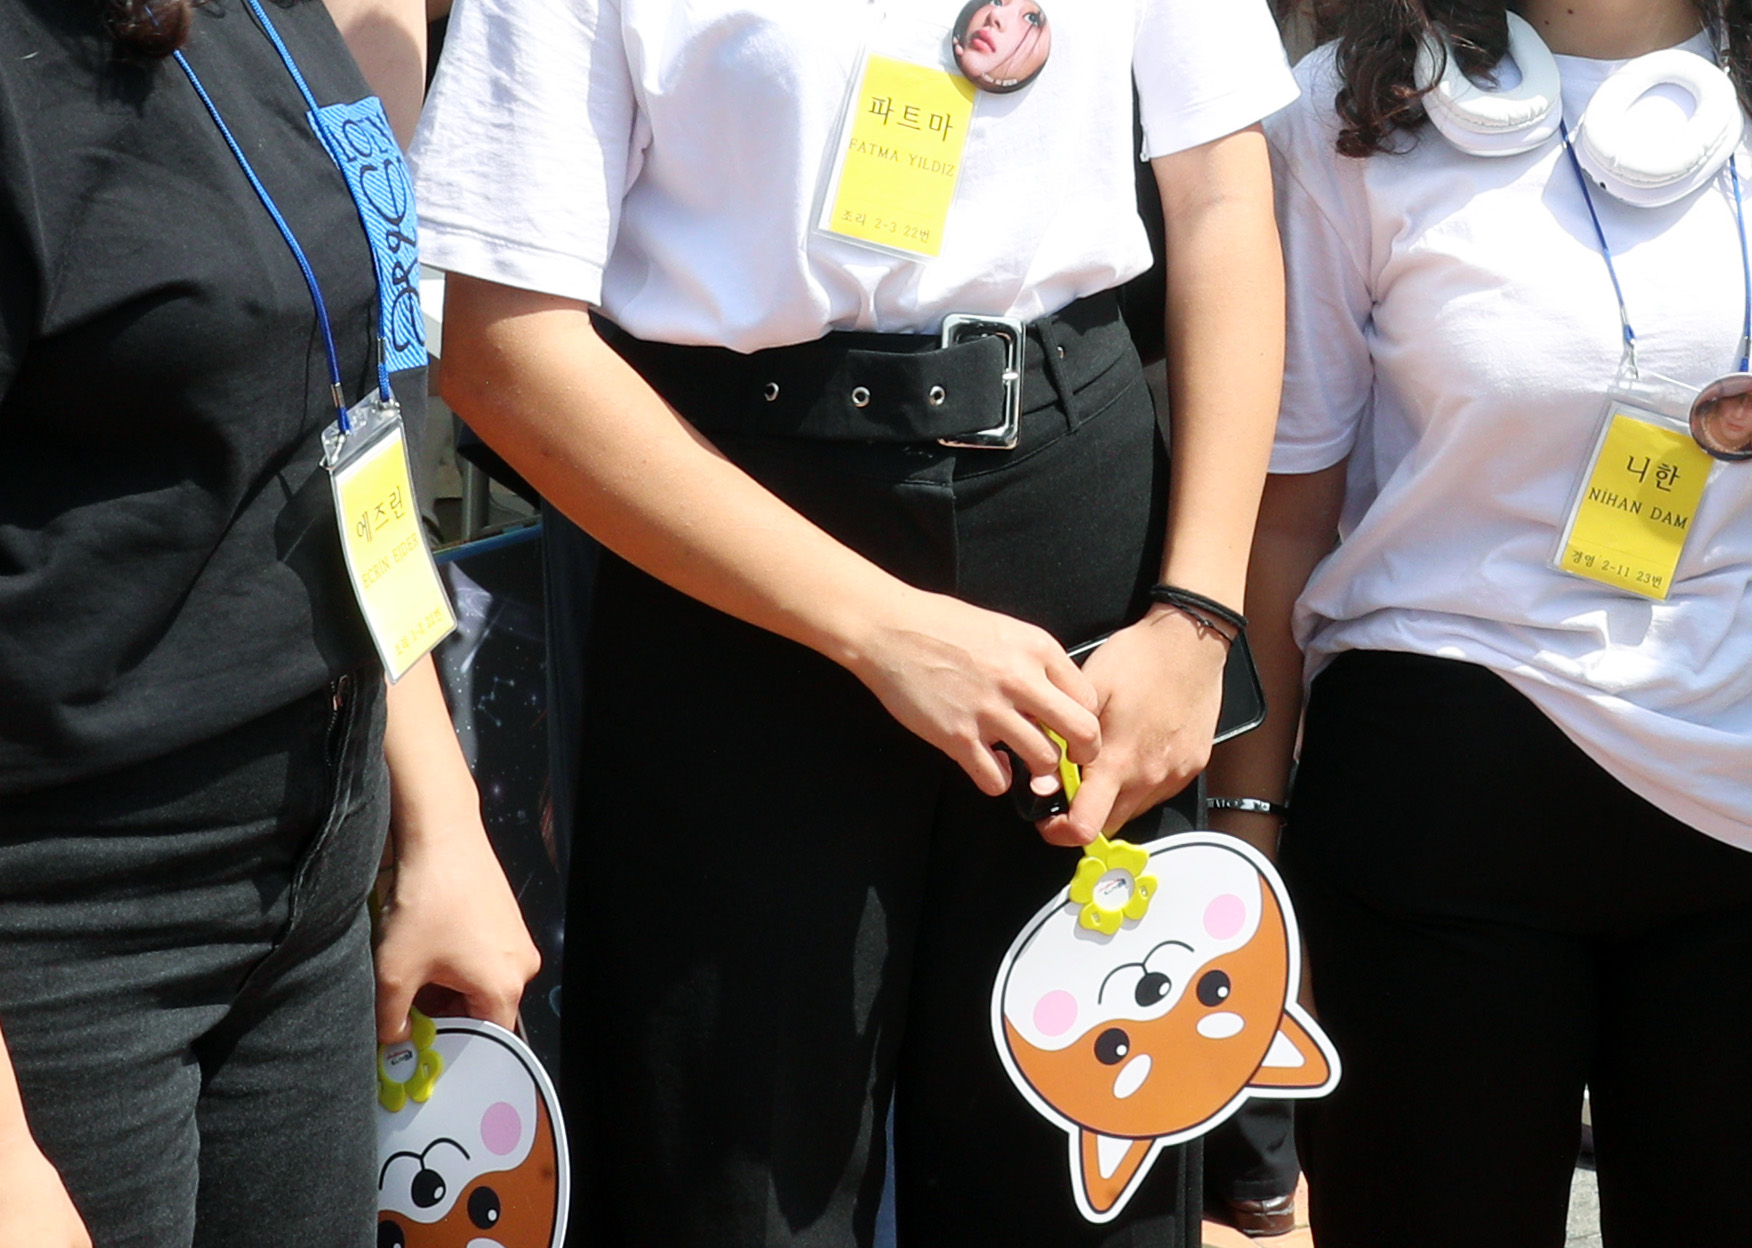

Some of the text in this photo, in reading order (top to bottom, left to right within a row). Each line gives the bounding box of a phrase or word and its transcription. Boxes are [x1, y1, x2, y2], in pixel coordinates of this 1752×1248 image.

[868, 97, 953, 141] 파트마
[848, 138, 898, 161] FATMA
[1626, 456, 1680, 490] 니한
[356, 486, 404, 541] 에즈린
[1650, 508, 1688, 528] DAM
